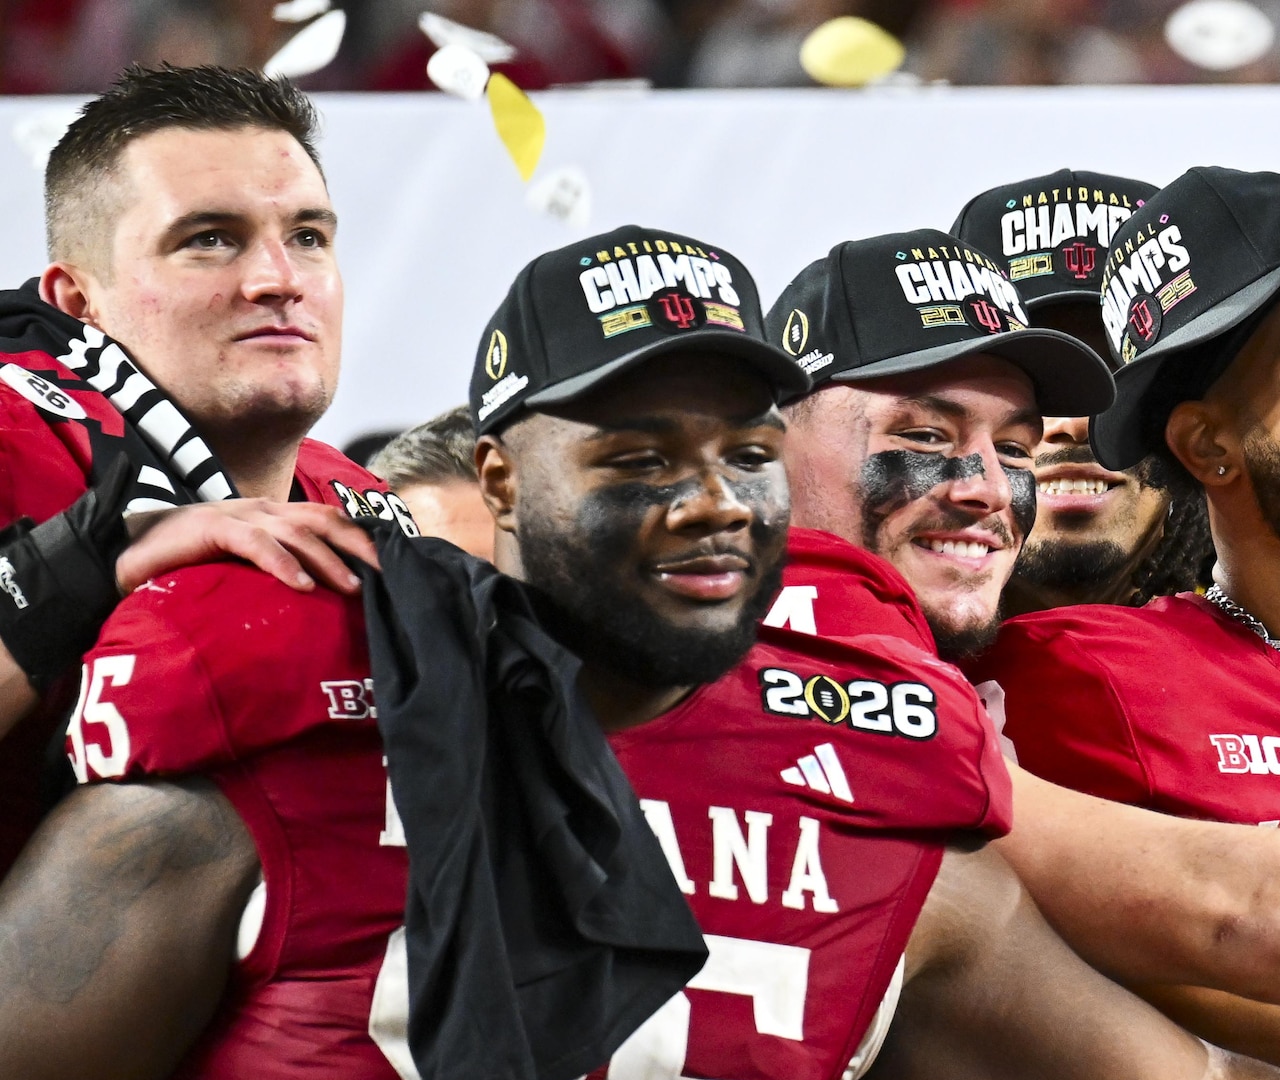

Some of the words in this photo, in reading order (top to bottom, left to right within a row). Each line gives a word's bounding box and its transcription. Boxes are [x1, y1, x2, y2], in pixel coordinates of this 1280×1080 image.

[1023, 187, 1131, 207] NATIONAL
[1001, 203, 1138, 256] CHAMP
[596, 240, 709, 262] NATIONAL
[911, 246, 1001, 273] NATIONAL
[579, 253, 741, 313] CHAMPS
